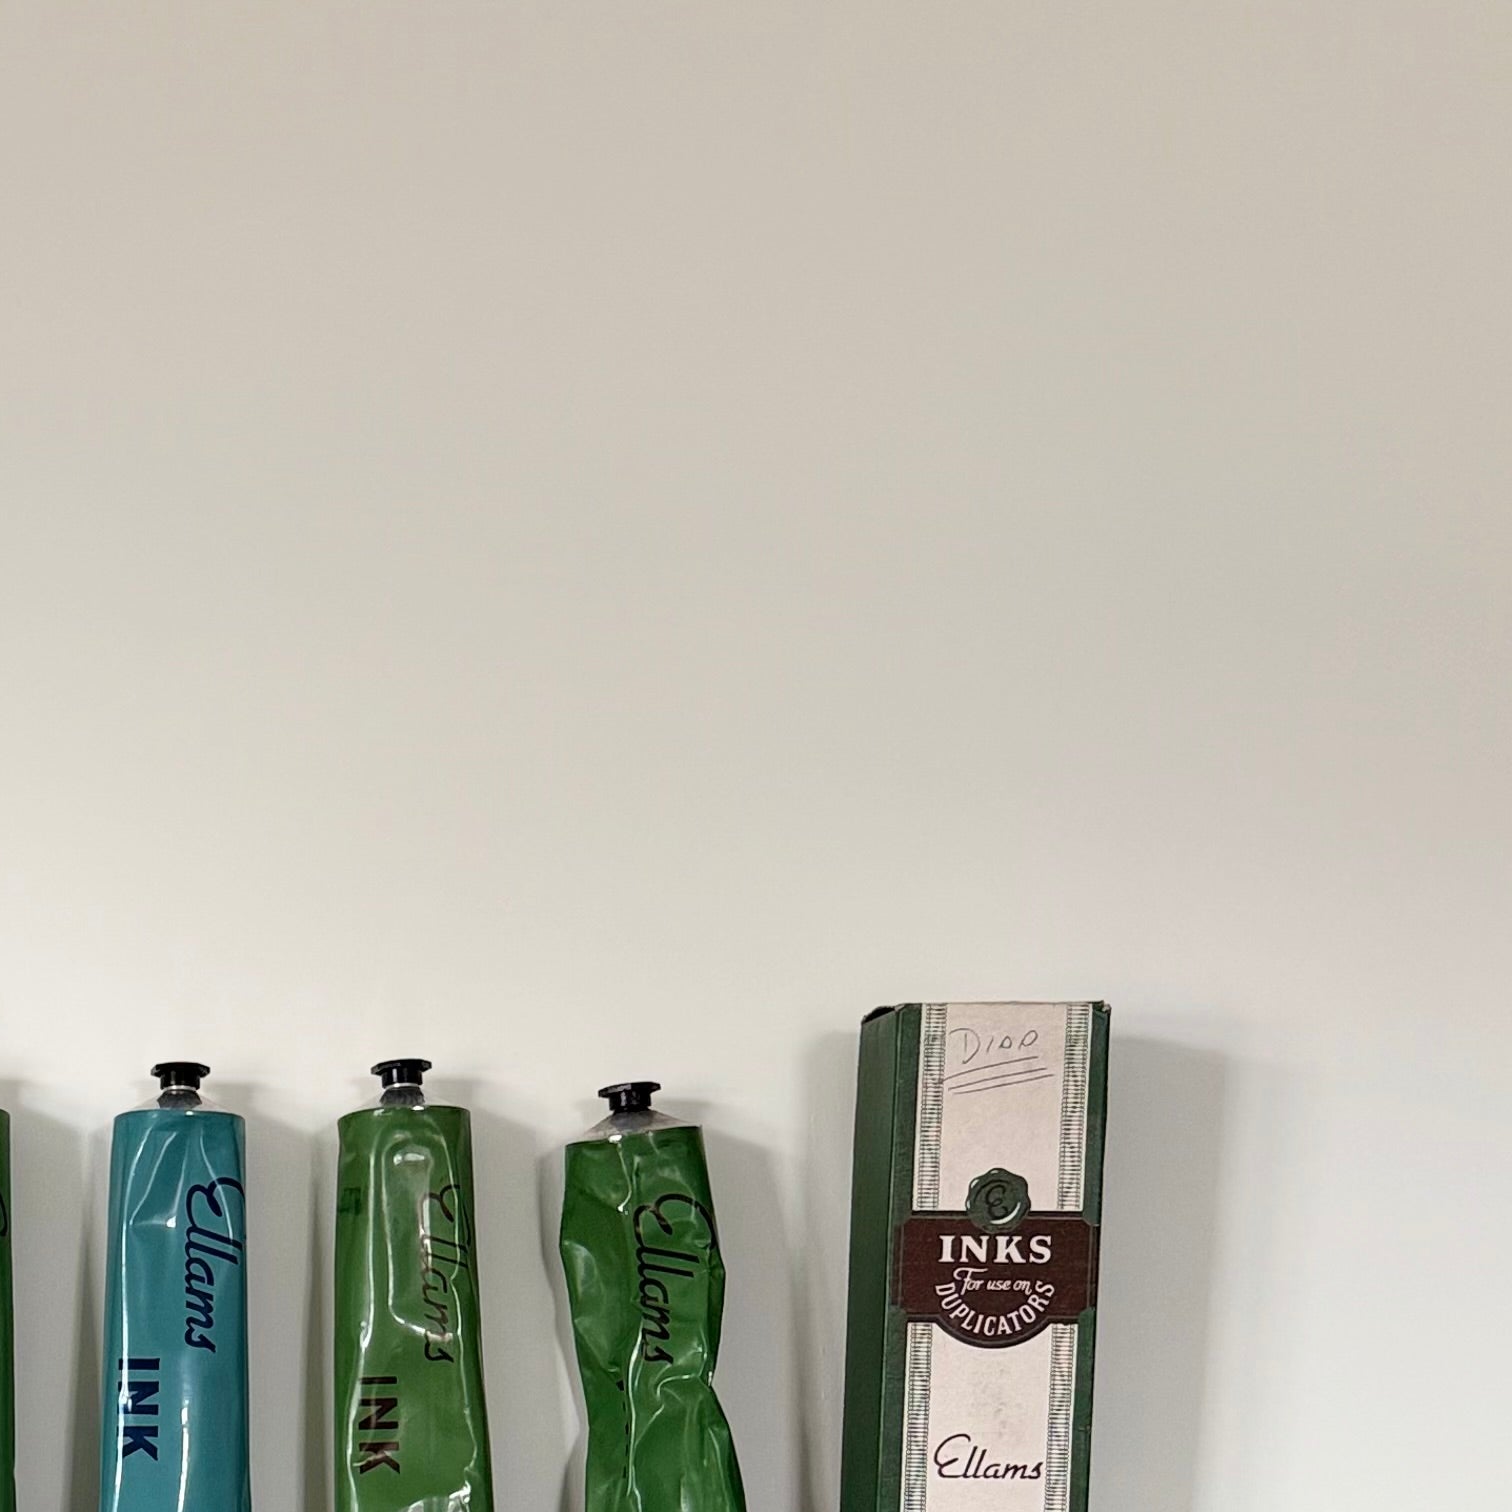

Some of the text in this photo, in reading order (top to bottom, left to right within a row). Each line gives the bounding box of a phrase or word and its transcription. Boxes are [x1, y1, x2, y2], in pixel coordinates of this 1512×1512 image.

[185, 1176, 248, 1354] Ellams
[633, 1193, 716, 1367] Ellams
[938, 1235, 1053, 1264] INKS
[953, 1267, 1033, 1296] For use on
[935, 1280, 1056, 1337] DUPLICATORS
[116, 1357, 161, 1462] INK
[358, 1375, 401, 1476] INK
[933, 1433, 1044, 1480] Ellams
